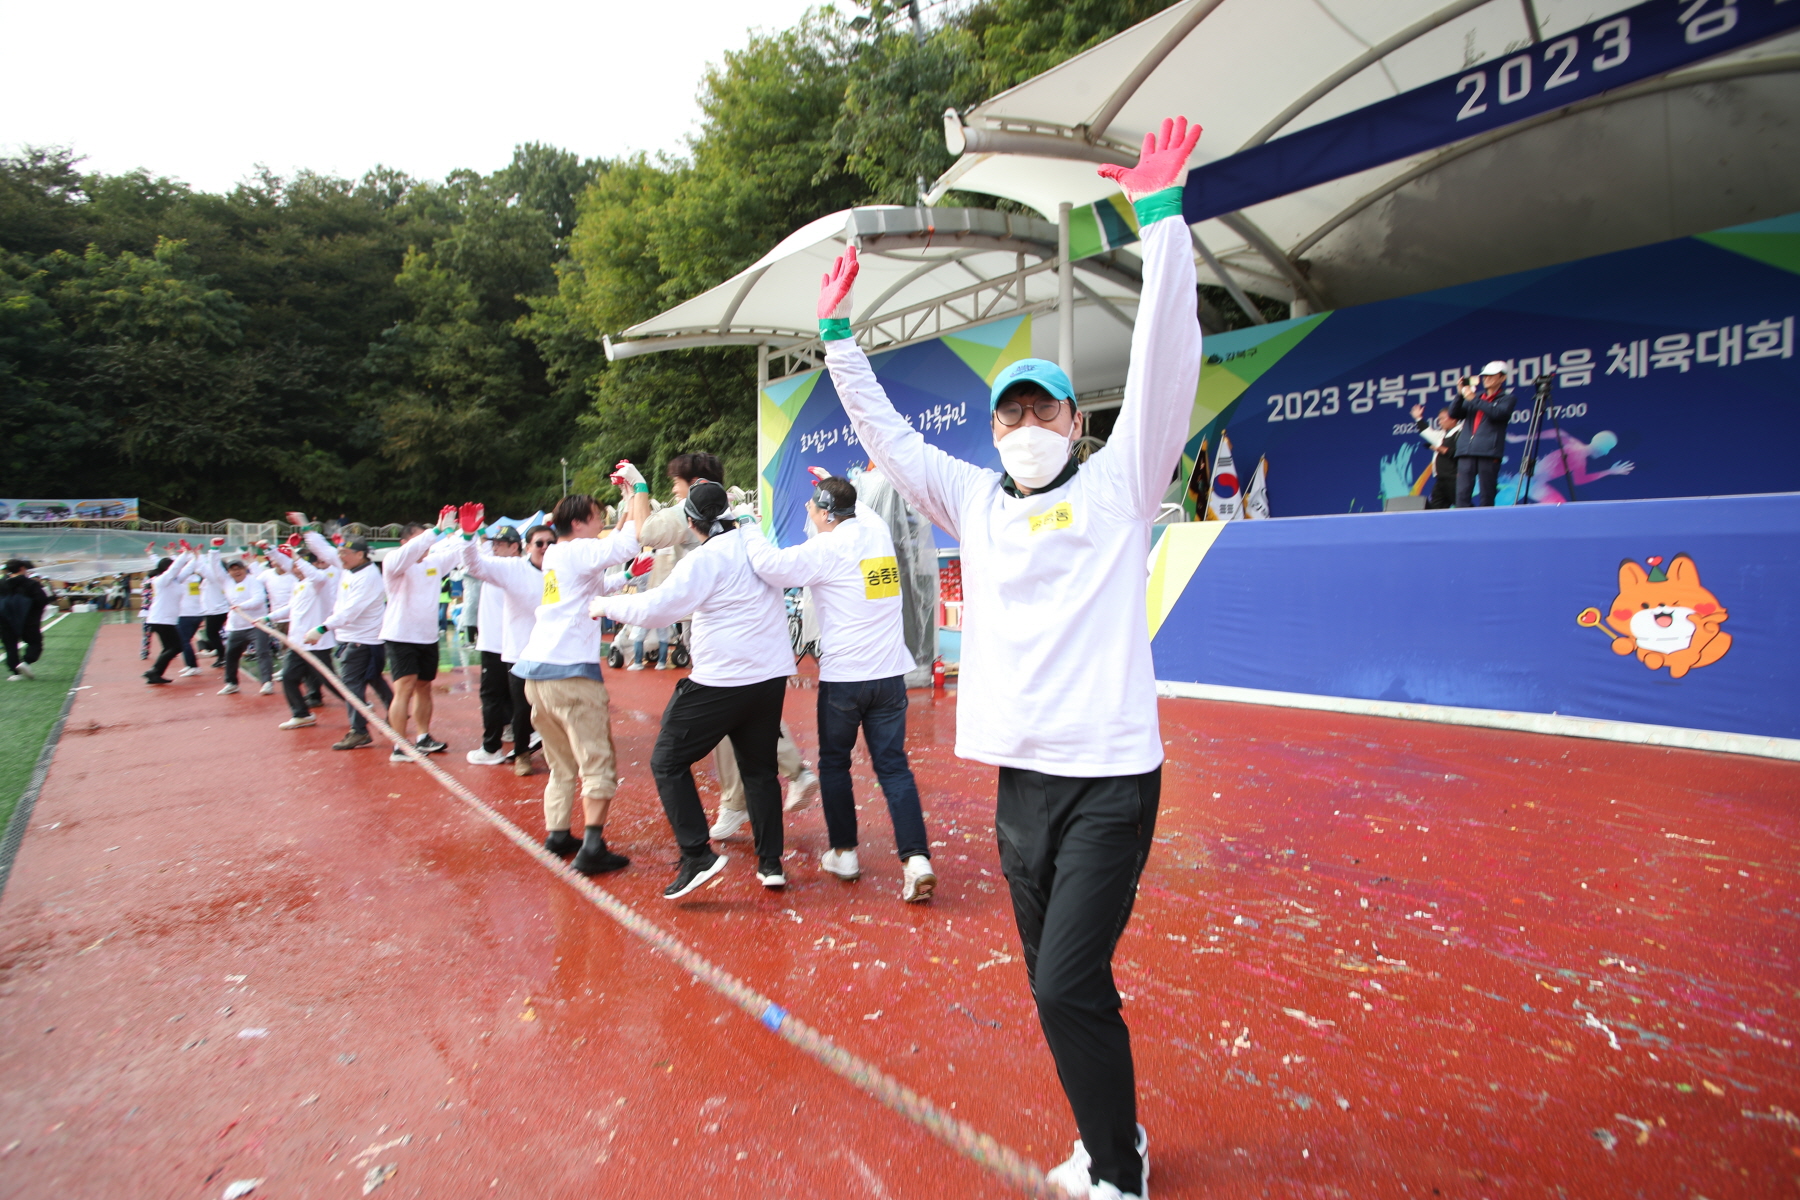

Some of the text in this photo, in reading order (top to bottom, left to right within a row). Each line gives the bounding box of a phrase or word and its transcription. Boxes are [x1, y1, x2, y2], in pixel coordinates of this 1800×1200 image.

[1456, 17, 1630, 122] 2023
[1267, 386, 1340, 422] 2023
[1347, 365, 1472, 414] 강북구민
[1604, 316, 1795, 379] 체육대회
[800, 428, 838, 453] 화합의
[918, 401, 967, 435] 강북구민
[1546, 402, 1588, 421] 17:00
